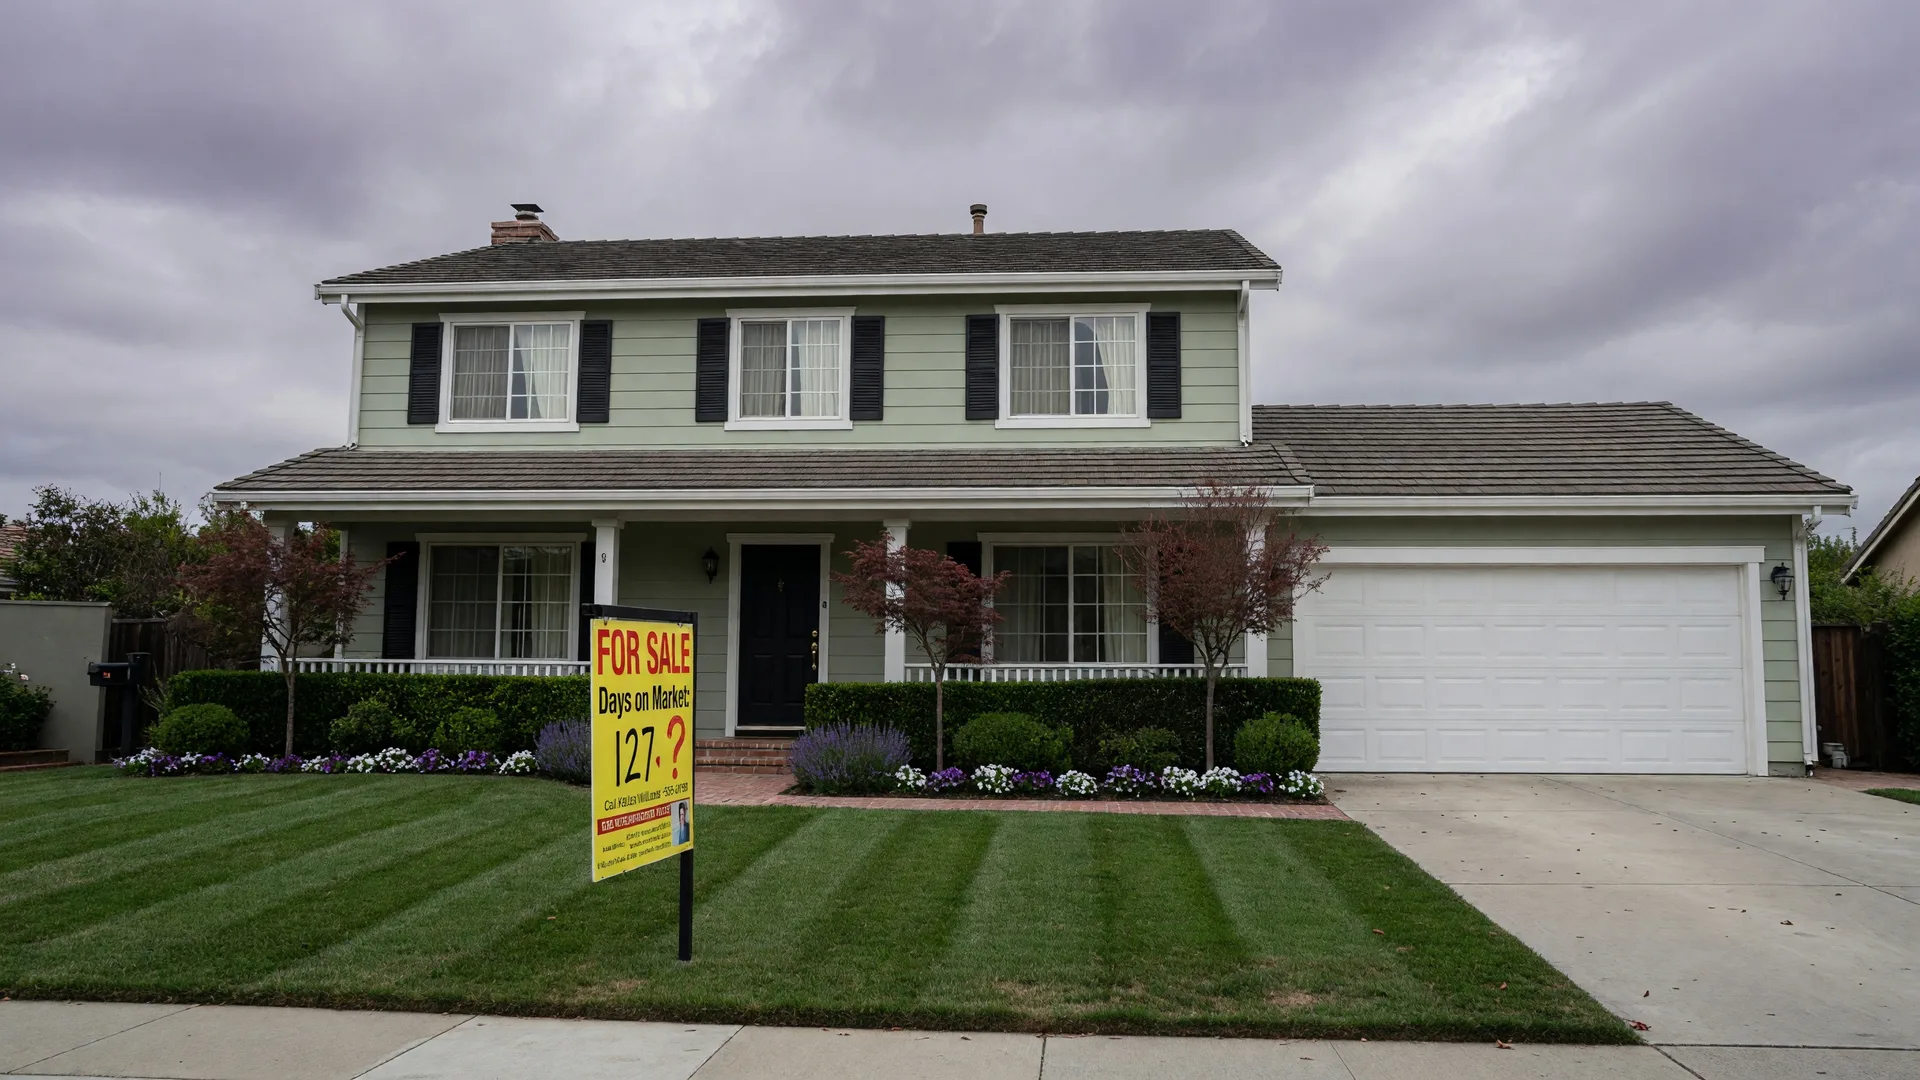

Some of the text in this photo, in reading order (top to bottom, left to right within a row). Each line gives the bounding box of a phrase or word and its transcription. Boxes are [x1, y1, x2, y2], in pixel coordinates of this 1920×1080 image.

[597, 629, 690, 676] FOR SALE
[598, 684, 690, 719] Days on Market:
